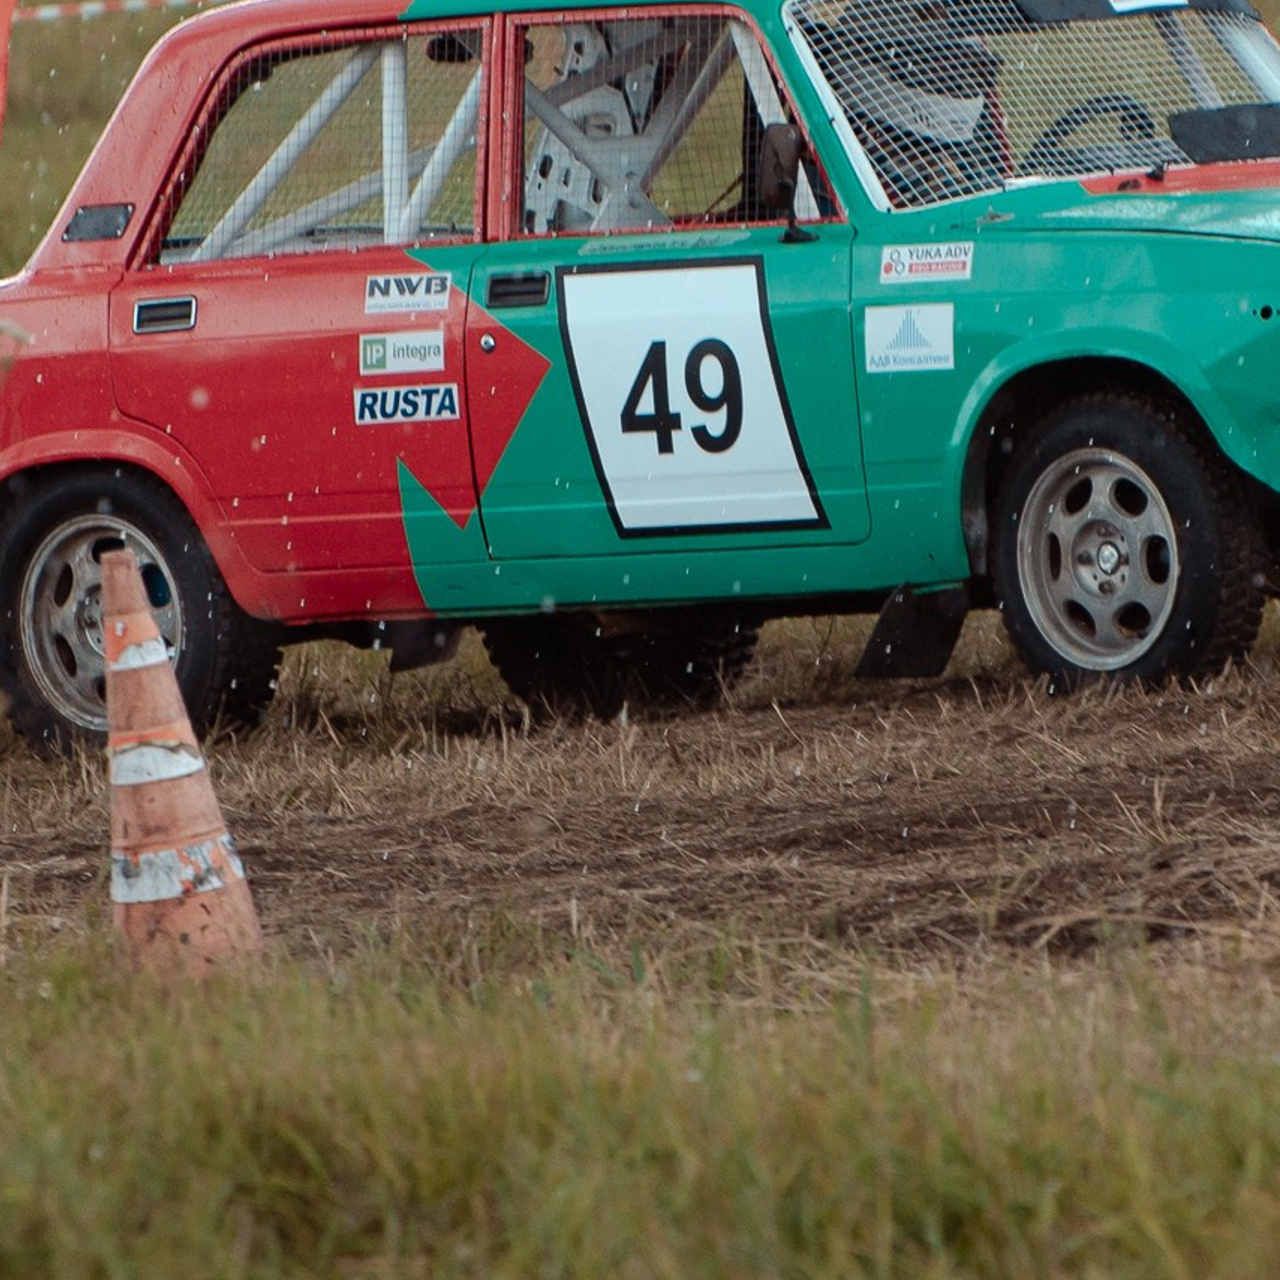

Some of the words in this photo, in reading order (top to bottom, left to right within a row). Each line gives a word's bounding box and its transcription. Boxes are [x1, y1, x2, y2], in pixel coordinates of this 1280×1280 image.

[908, 247, 942, 260] YUKA
[944, 246, 971, 258] ADV
[368, 276, 448, 297] NWB
[392, 343, 441, 362] integra
[358, 387, 457, 420] RUSTA
[620, 338, 743, 455] 49
